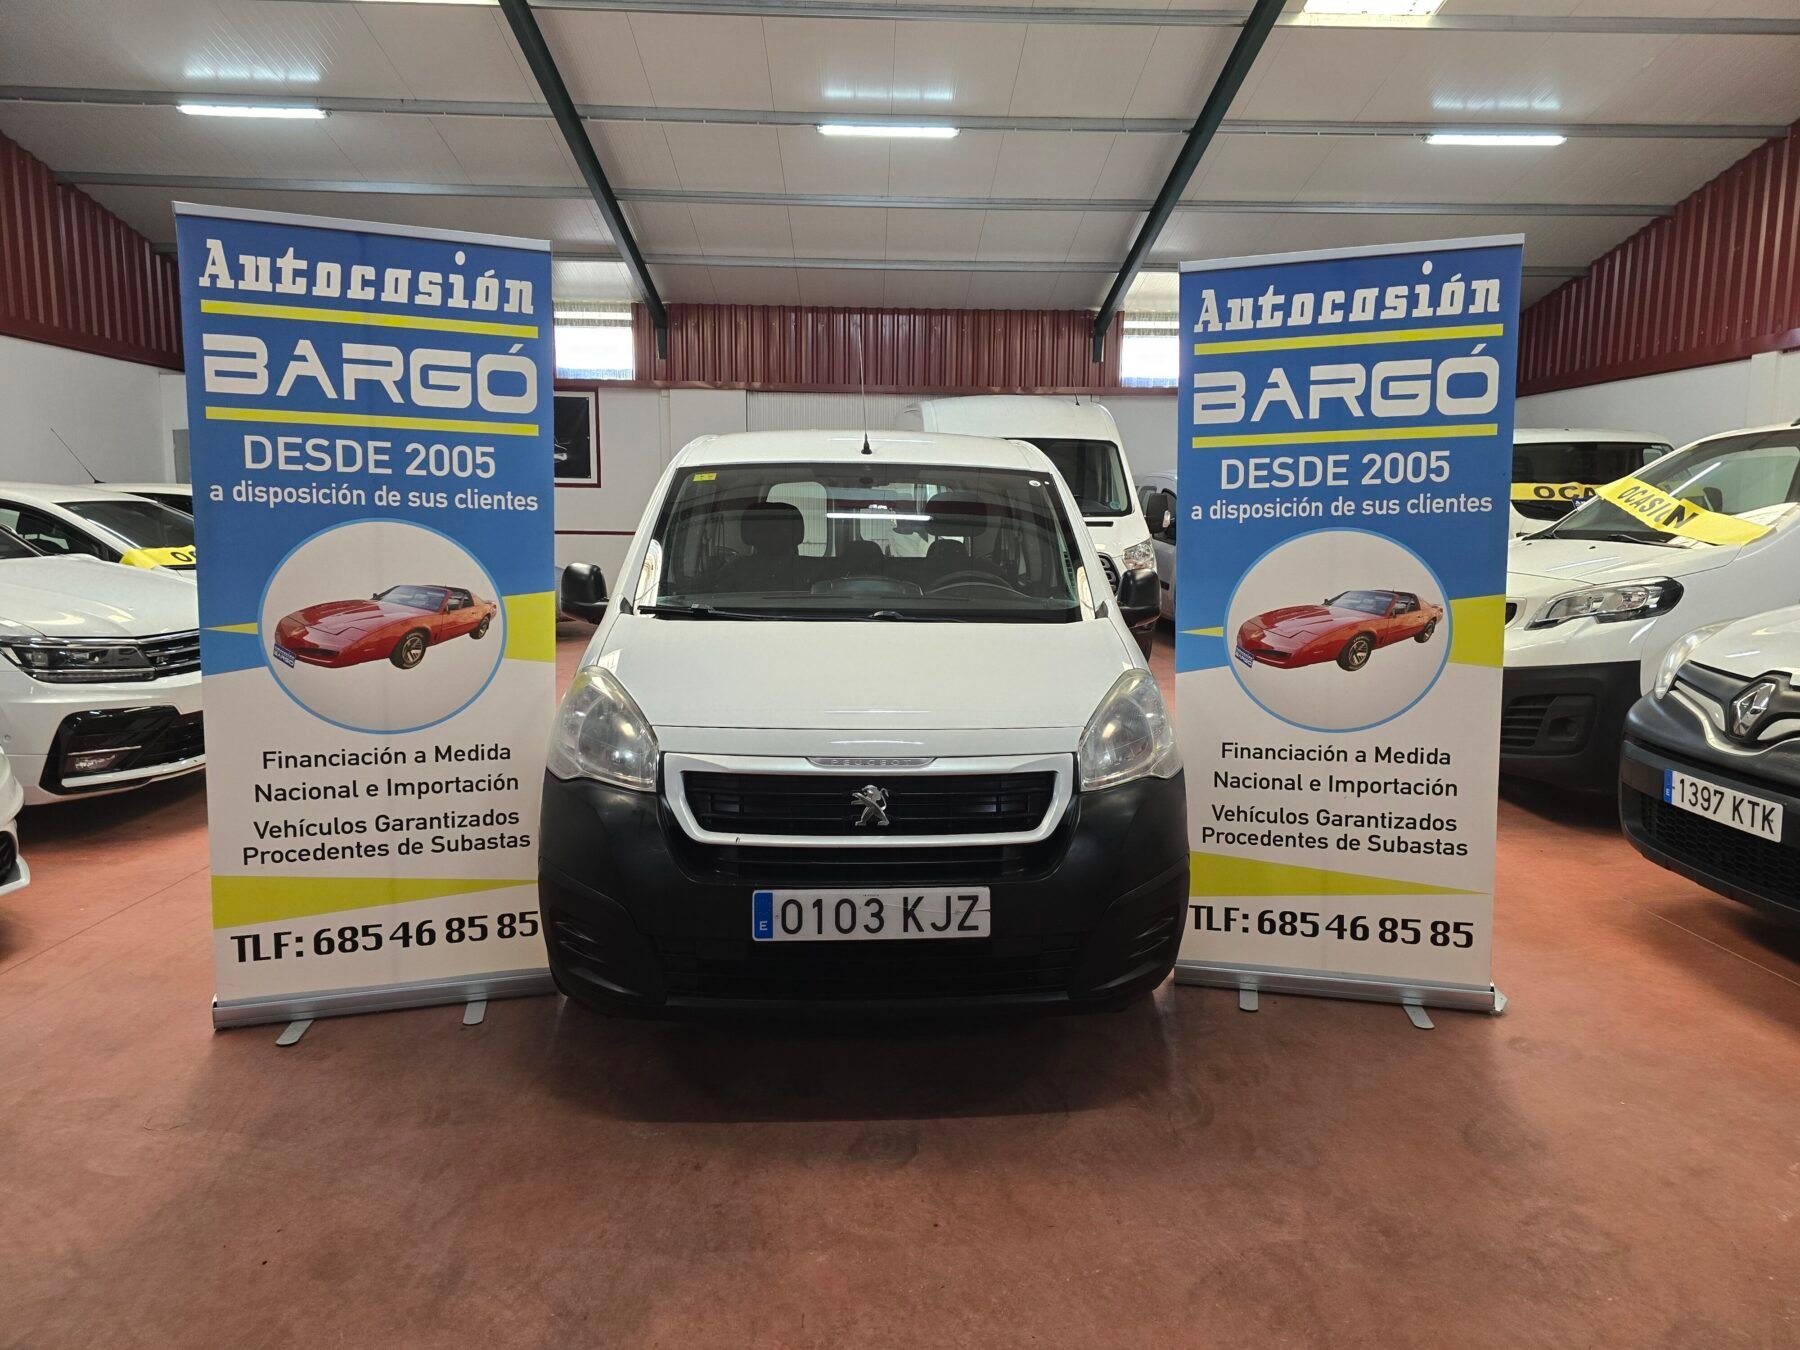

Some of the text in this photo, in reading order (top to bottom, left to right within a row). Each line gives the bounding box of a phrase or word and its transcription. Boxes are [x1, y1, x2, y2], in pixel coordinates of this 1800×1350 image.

[199, 239, 533, 314] Autocasión
[1194, 261, 1499, 332] Autocasión
[203, 334, 537, 413] BARGÓ
[1194, 344, 1499, 424] BARGÓ
[244, 435, 495, 478] DESDE 2005
[1222, 451, 1449, 489] DESDE 2005
[210, 480, 538, 511] a disposición de sus clientes
[1191, 494, 1492, 523] a disposición de sus clientes
[263, 744, 510, 769] Financiación a Medida
[1222, 742, 1450, 765] Financiación a Medida
[255, 774, 518, 802] Nacional e Importación
[1214, 771, 1457, 797] Nacional e Importación
[253, 809, 519, 839] Vehículos Garantizados
[1212, 804, 1457, 831] Vehículos Garantizados
[1680, 779, 1724, 814] 1397
[1732, 796, 1775, 834] KTK
[244, 833, 530, 865] Procedentes de Subastas
[1203, 827, 1467, 856] Procedentes de Subastas
[759, 895, 978, 934] E 0103 KJZ
[1189, 905, 1473, 948] TLF: 685 46 85 85
[231, 911, 538, 962] TLF: 685 46 85 85
